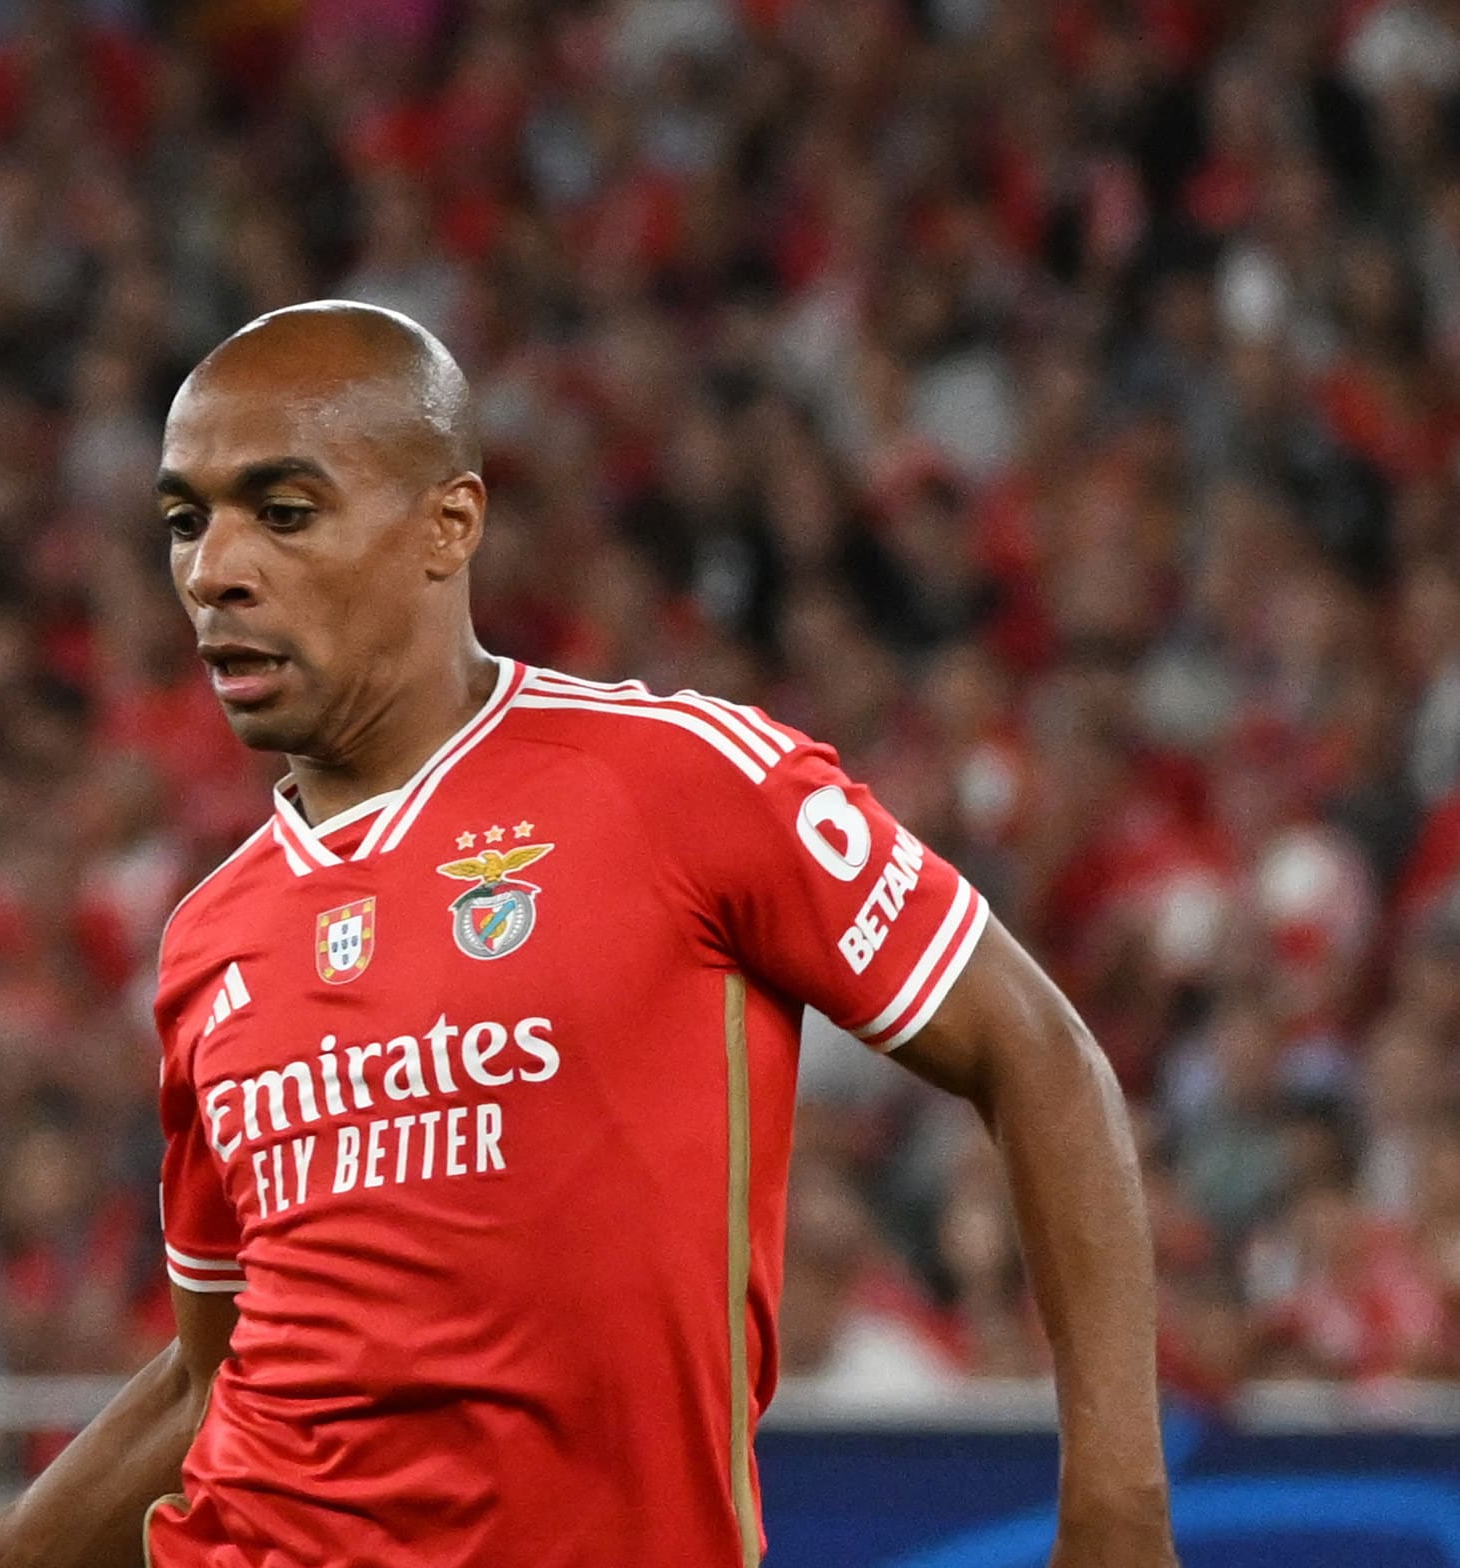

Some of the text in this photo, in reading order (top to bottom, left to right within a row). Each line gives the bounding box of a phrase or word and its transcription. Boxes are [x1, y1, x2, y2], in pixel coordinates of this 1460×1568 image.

[204, 1012, 560, 1164] Emirates
[251, 1102, 507, 1220] FLY BETTER
